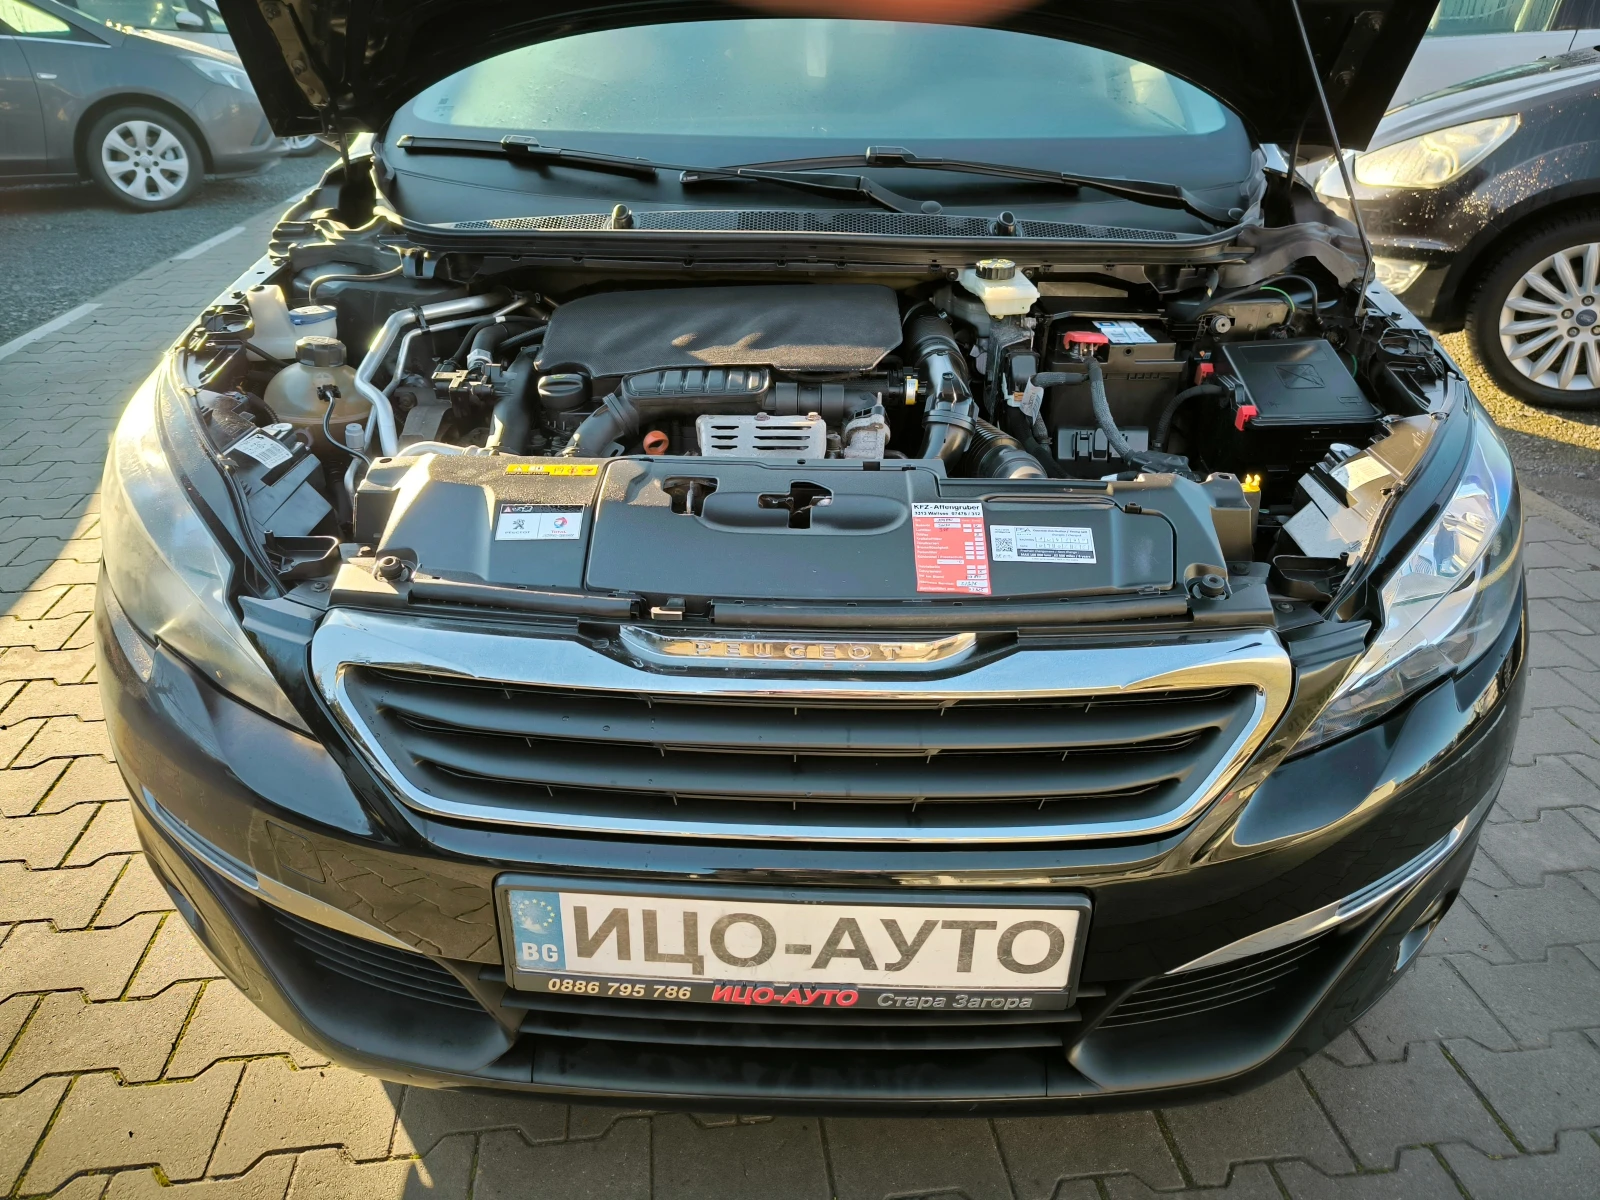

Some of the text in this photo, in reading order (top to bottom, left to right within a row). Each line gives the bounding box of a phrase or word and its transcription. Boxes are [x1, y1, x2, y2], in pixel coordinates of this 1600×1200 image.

[694, 640, 903, 661] PEUGEOT
[573, 905, 1066, 976] ИЦО-АУТО
[521, 942, 559, 963] BG
[547, 978, 692, 1000] 0886 795 786
[711, 985, 859, 1007] ИЦО-АУТО
[877, 993, 1034, 1010] Стара Загора
